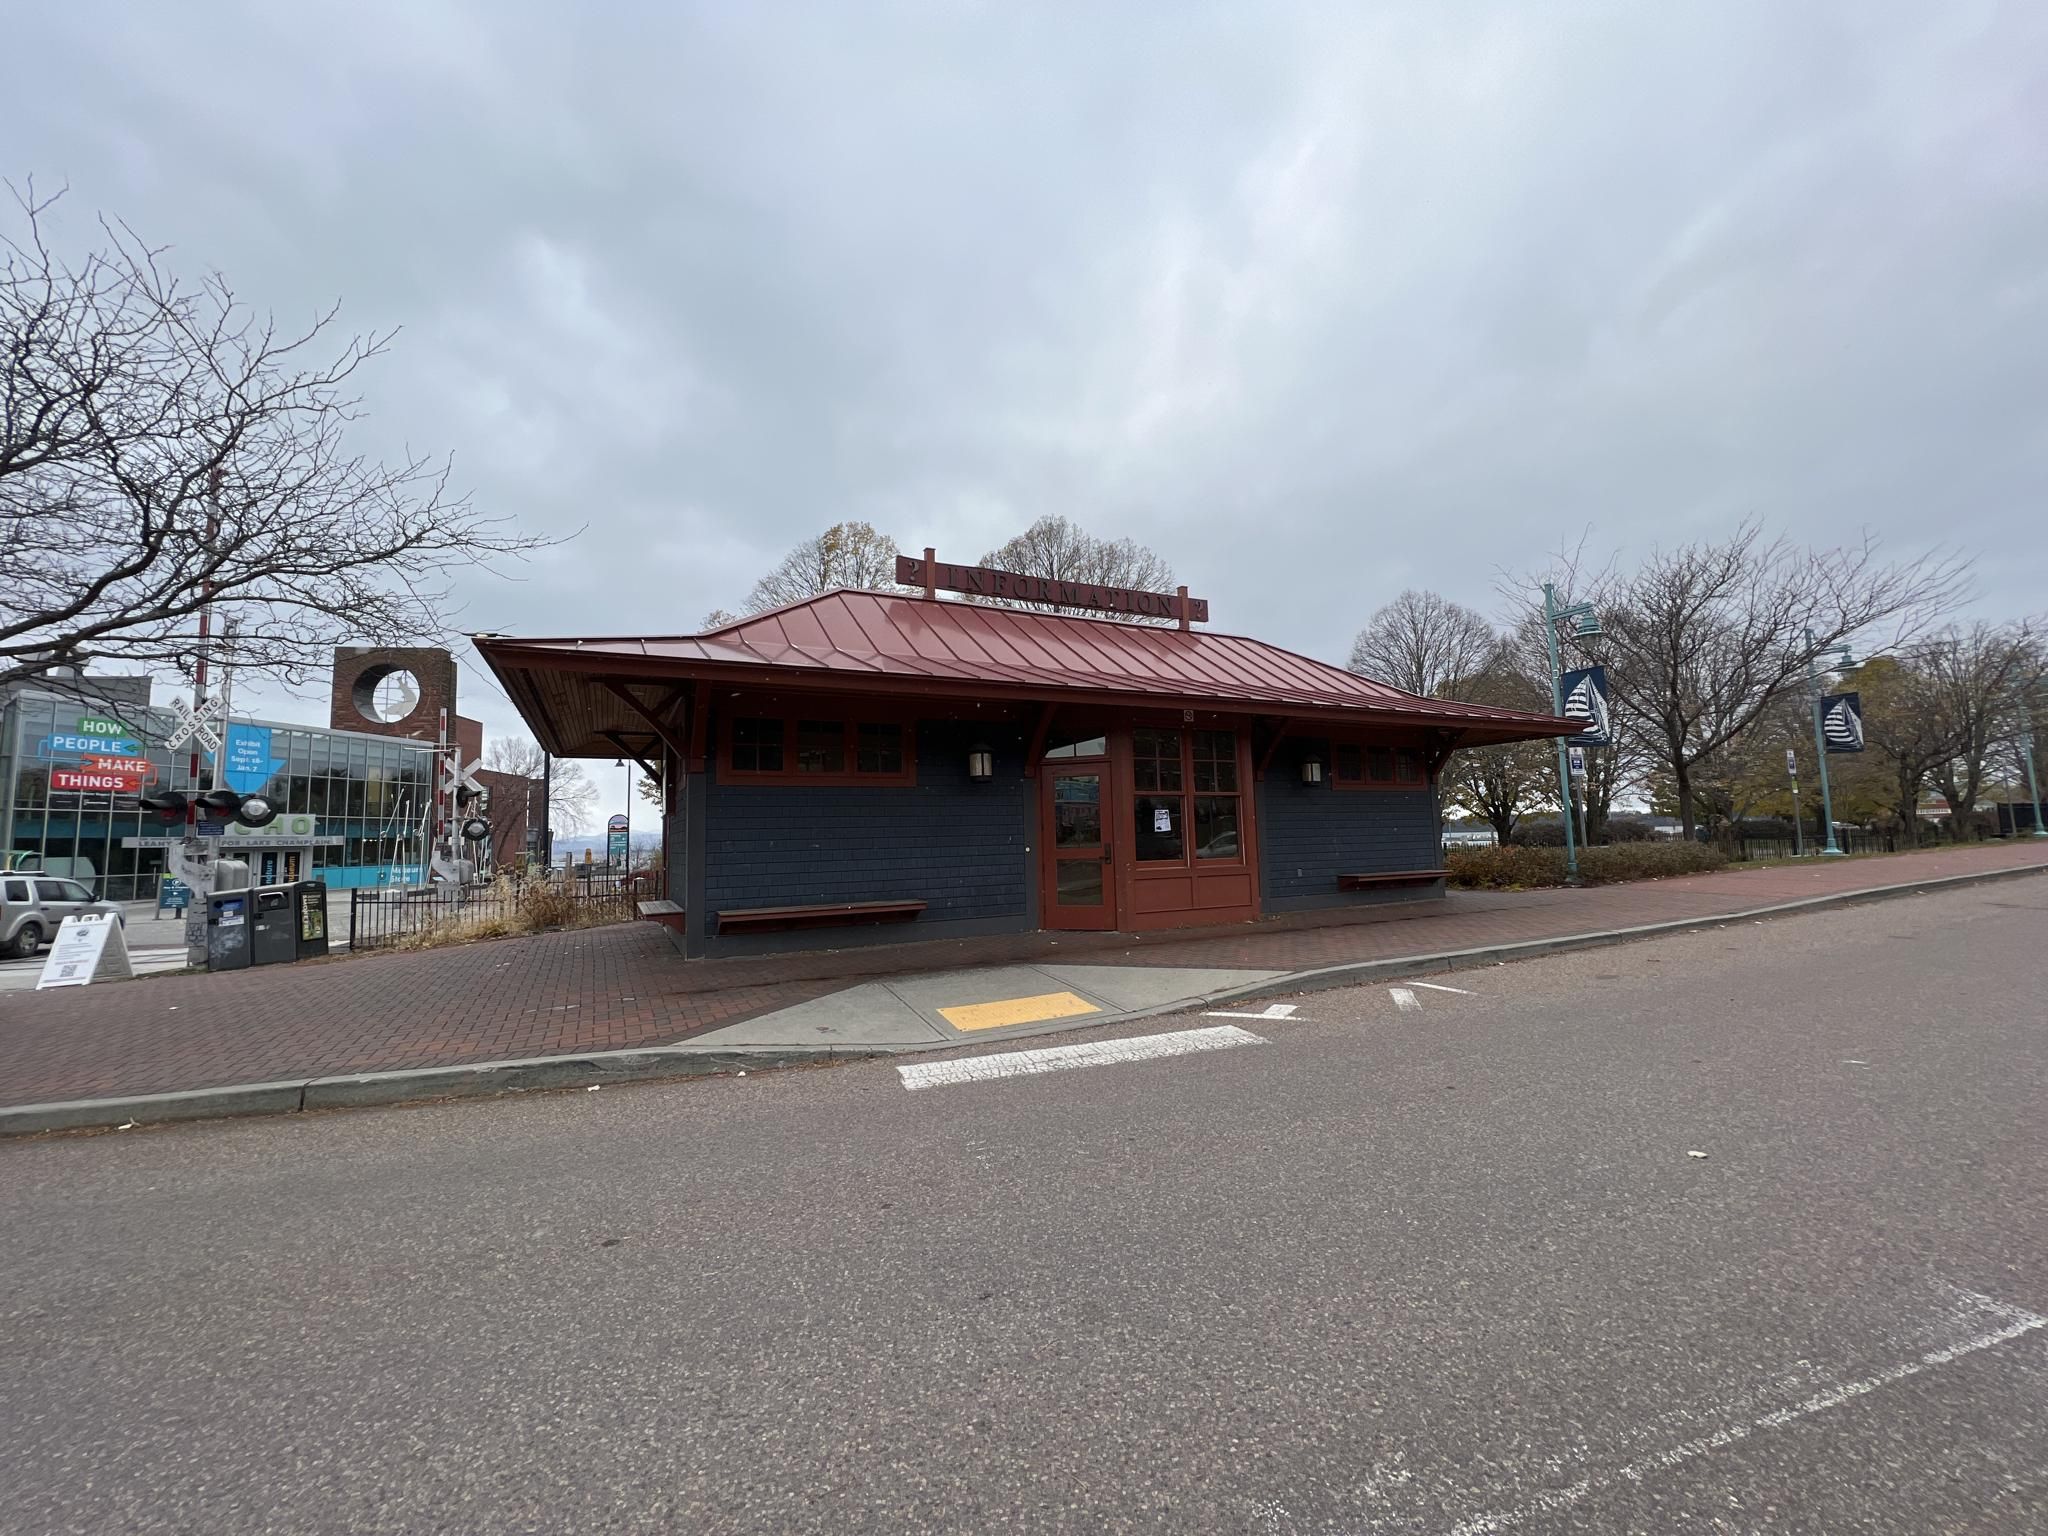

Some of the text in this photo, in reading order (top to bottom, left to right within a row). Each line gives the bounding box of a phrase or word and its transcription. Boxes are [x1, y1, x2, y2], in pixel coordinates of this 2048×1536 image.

[946, 566, 1174, 617] INFORMATION
[83, 720, 122, 735] HOW
[168, 698, 219, 750] CROSSING
[170, 697, 217, 752] RAIL ROAD
[53, 736, 122, 753] PEOPLE
[235, 739, 261, 748] Exhibit
[237, 748, 259, 756] Open
[97, 758, 147, 773] MAKE
[57, 773, 125, 789] THINGS
[391, 866, 423, 874] Mueum
[391, 875, 411, 883] Stoe
